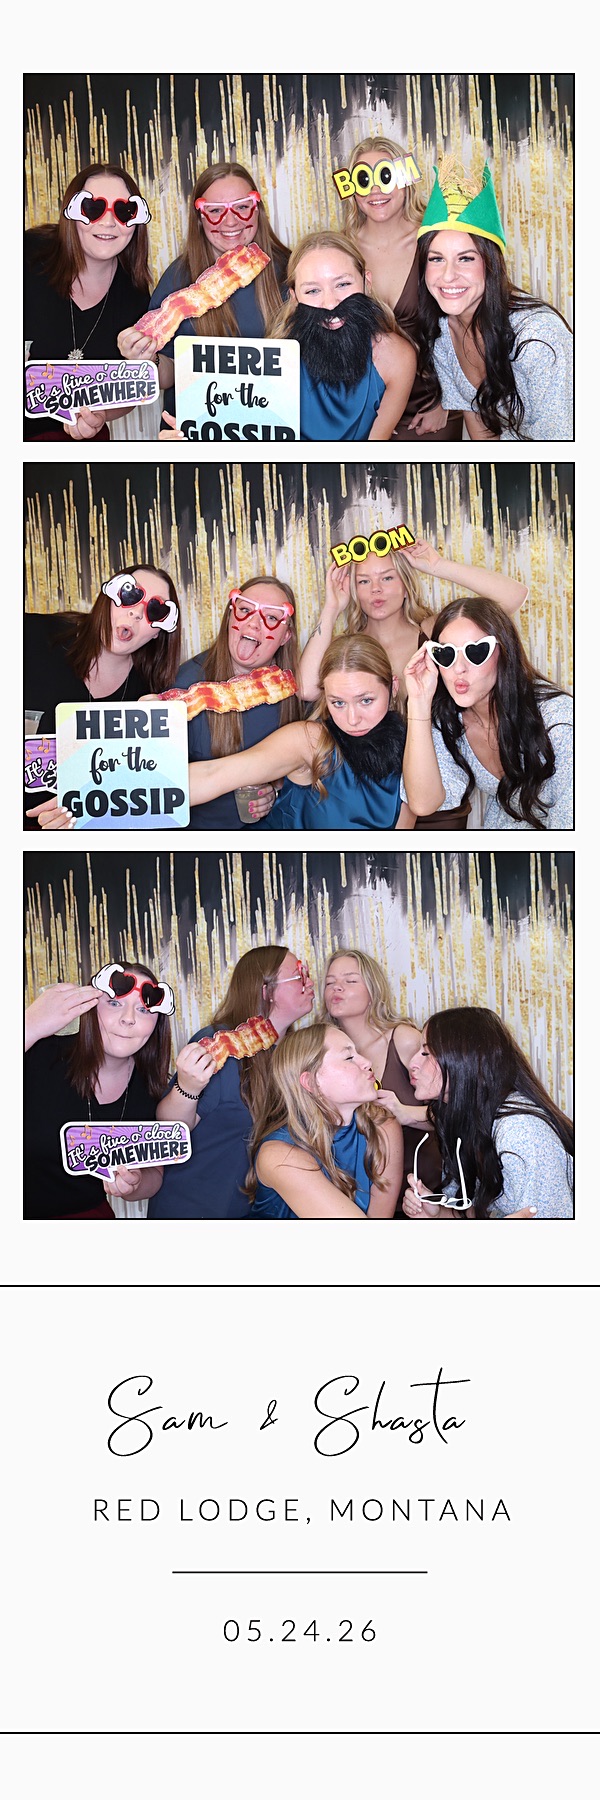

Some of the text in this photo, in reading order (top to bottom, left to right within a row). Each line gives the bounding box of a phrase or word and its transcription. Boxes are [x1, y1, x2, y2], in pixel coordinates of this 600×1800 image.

[332, 152, 422, 200] BOOM
[192, 344, 282, 376] HERE
[26, 361, 150, 410] It's five o'clock
[45, 380, 156, 413] SOMEWHERE
[205, 381, 269, 417] for the
[331, 523, 415, 568] BOOM
[76, 709, 170, 740] HERE
[89, 747, 121, 785] for
[122, 746, 157, 772] the
[62, 788, 185, 818] GOSSIP
[68, 1123, 182, 1168] It's five o'clock
[85, 1141, 189, 1172] SOMEWHERE
